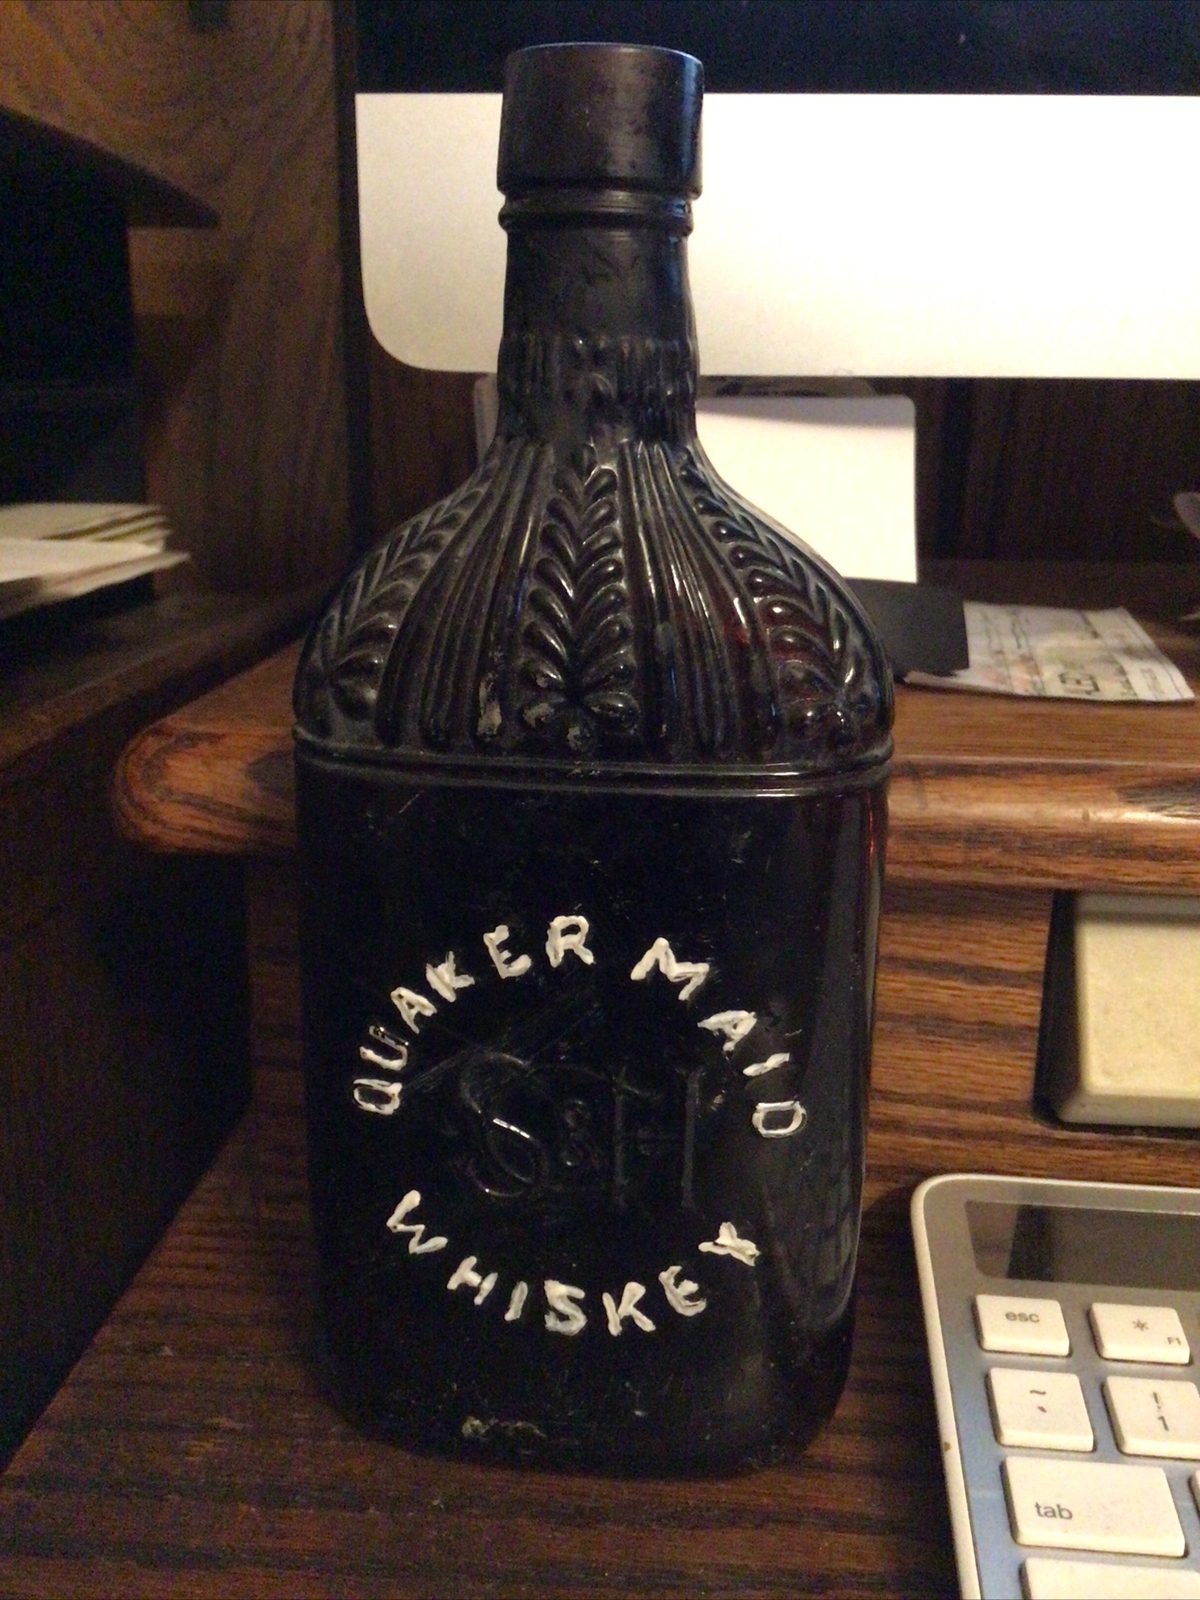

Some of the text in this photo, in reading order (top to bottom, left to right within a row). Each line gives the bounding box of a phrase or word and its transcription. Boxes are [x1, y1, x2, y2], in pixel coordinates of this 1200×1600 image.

[352, 914, 596, 1117] QUAKER
[630, 936, 808, 1139] MAID
[386, 1189, 762, 1337] WHISKEY
[1005, 1310, 1041, 1325] esc
[1166, 1335, 1182, 1346] F1
[1034, 1501, 1074, 1521] tab
